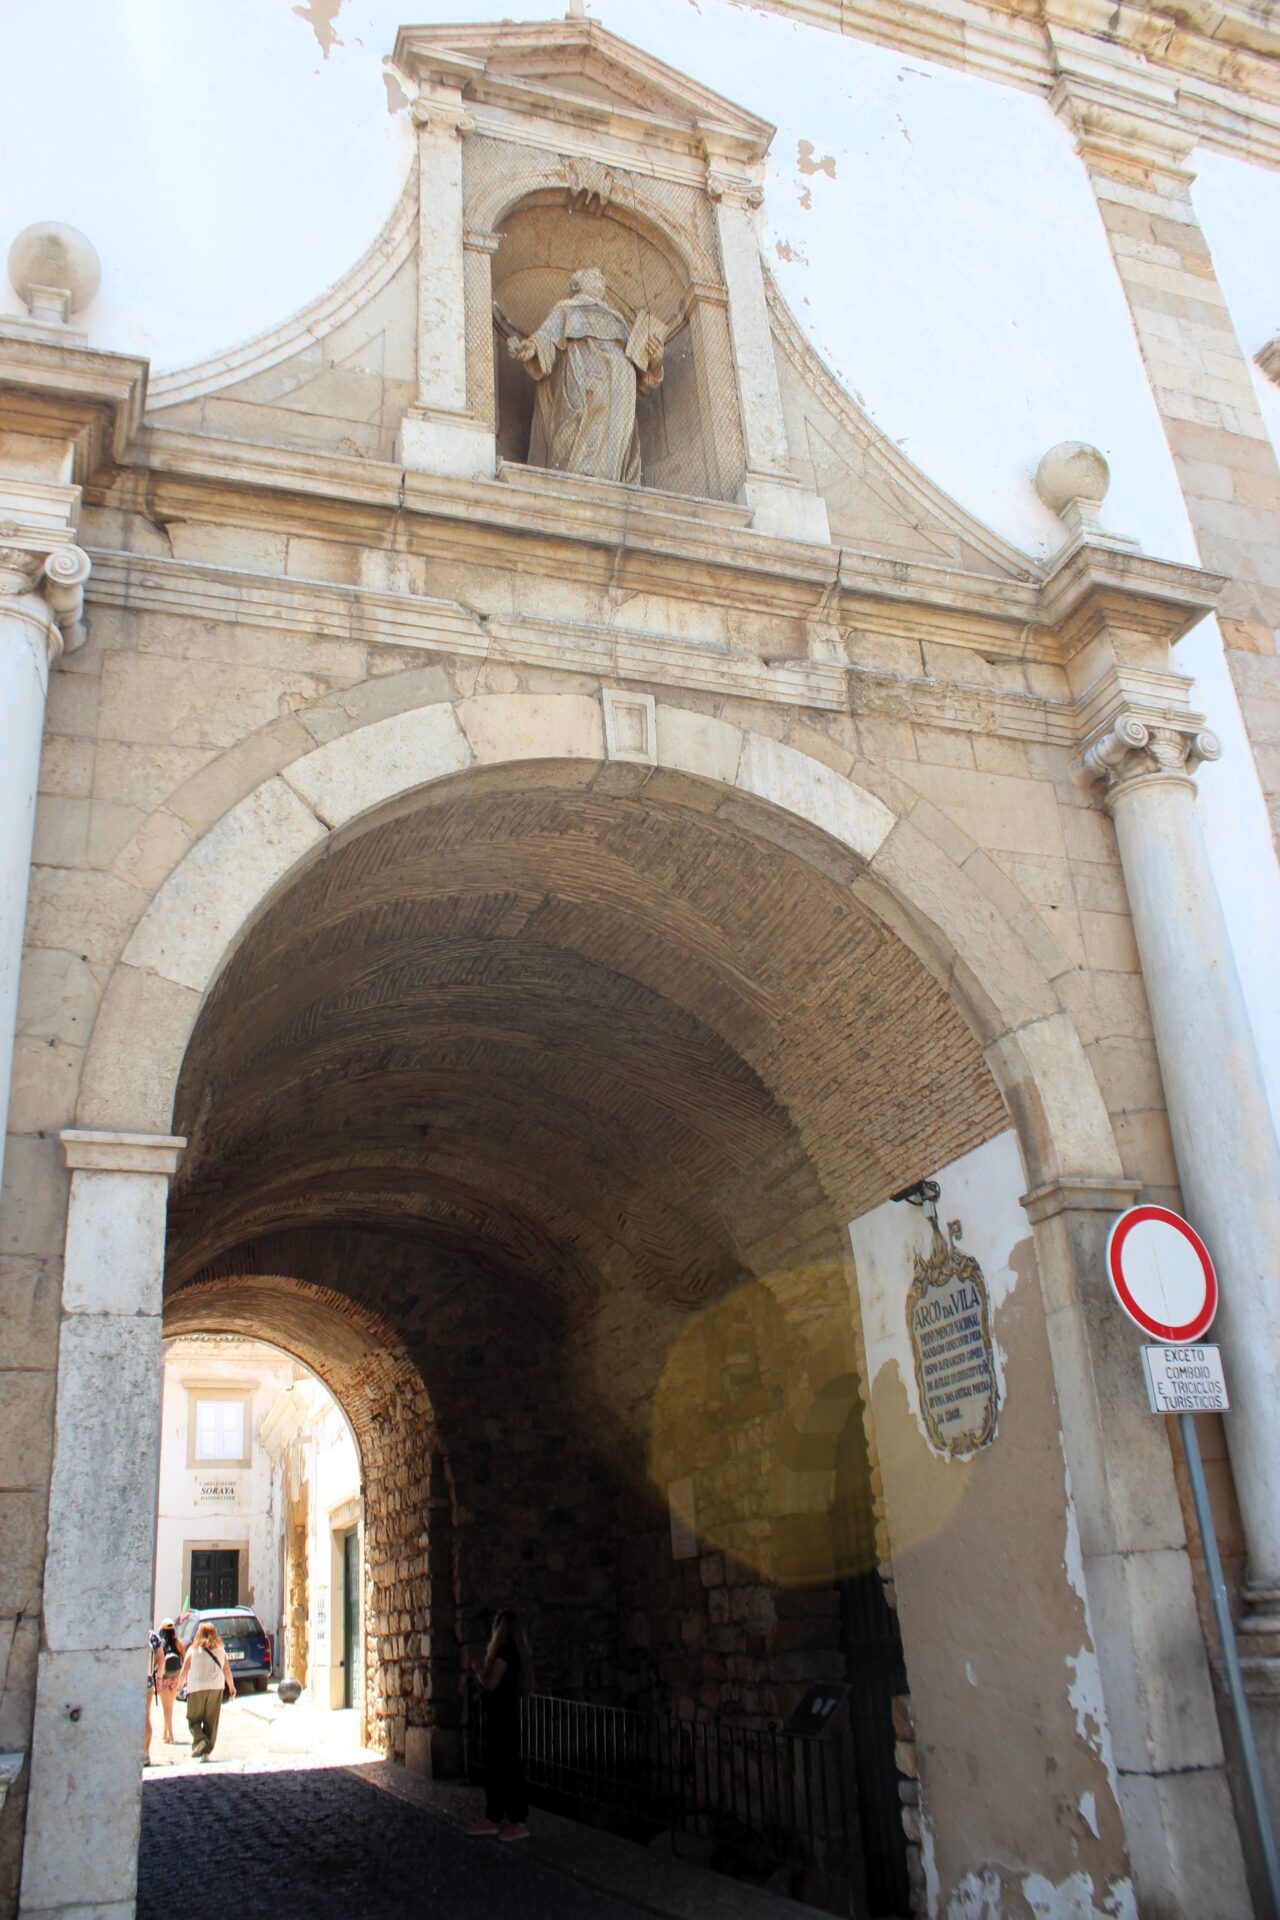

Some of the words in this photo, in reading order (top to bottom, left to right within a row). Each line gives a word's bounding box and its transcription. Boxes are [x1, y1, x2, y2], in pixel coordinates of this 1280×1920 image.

[914, 1300, 941, 1331] ARCO
[942, 1304, 954, 1319] DA
[950, 1285, 980, 1314] VILA
[954, 1312, 980, 1333] NACIONAL
[1164, 1349, 1205, 1362] EXCETO
[1165, 1367, 1210, 1380] COMBOIO
[1157, 1382, 1165, 1395] E
[1172, 1381, 1223, 1394] TRICICLOS
[201, 1487, 234, 1495] SORAYA
